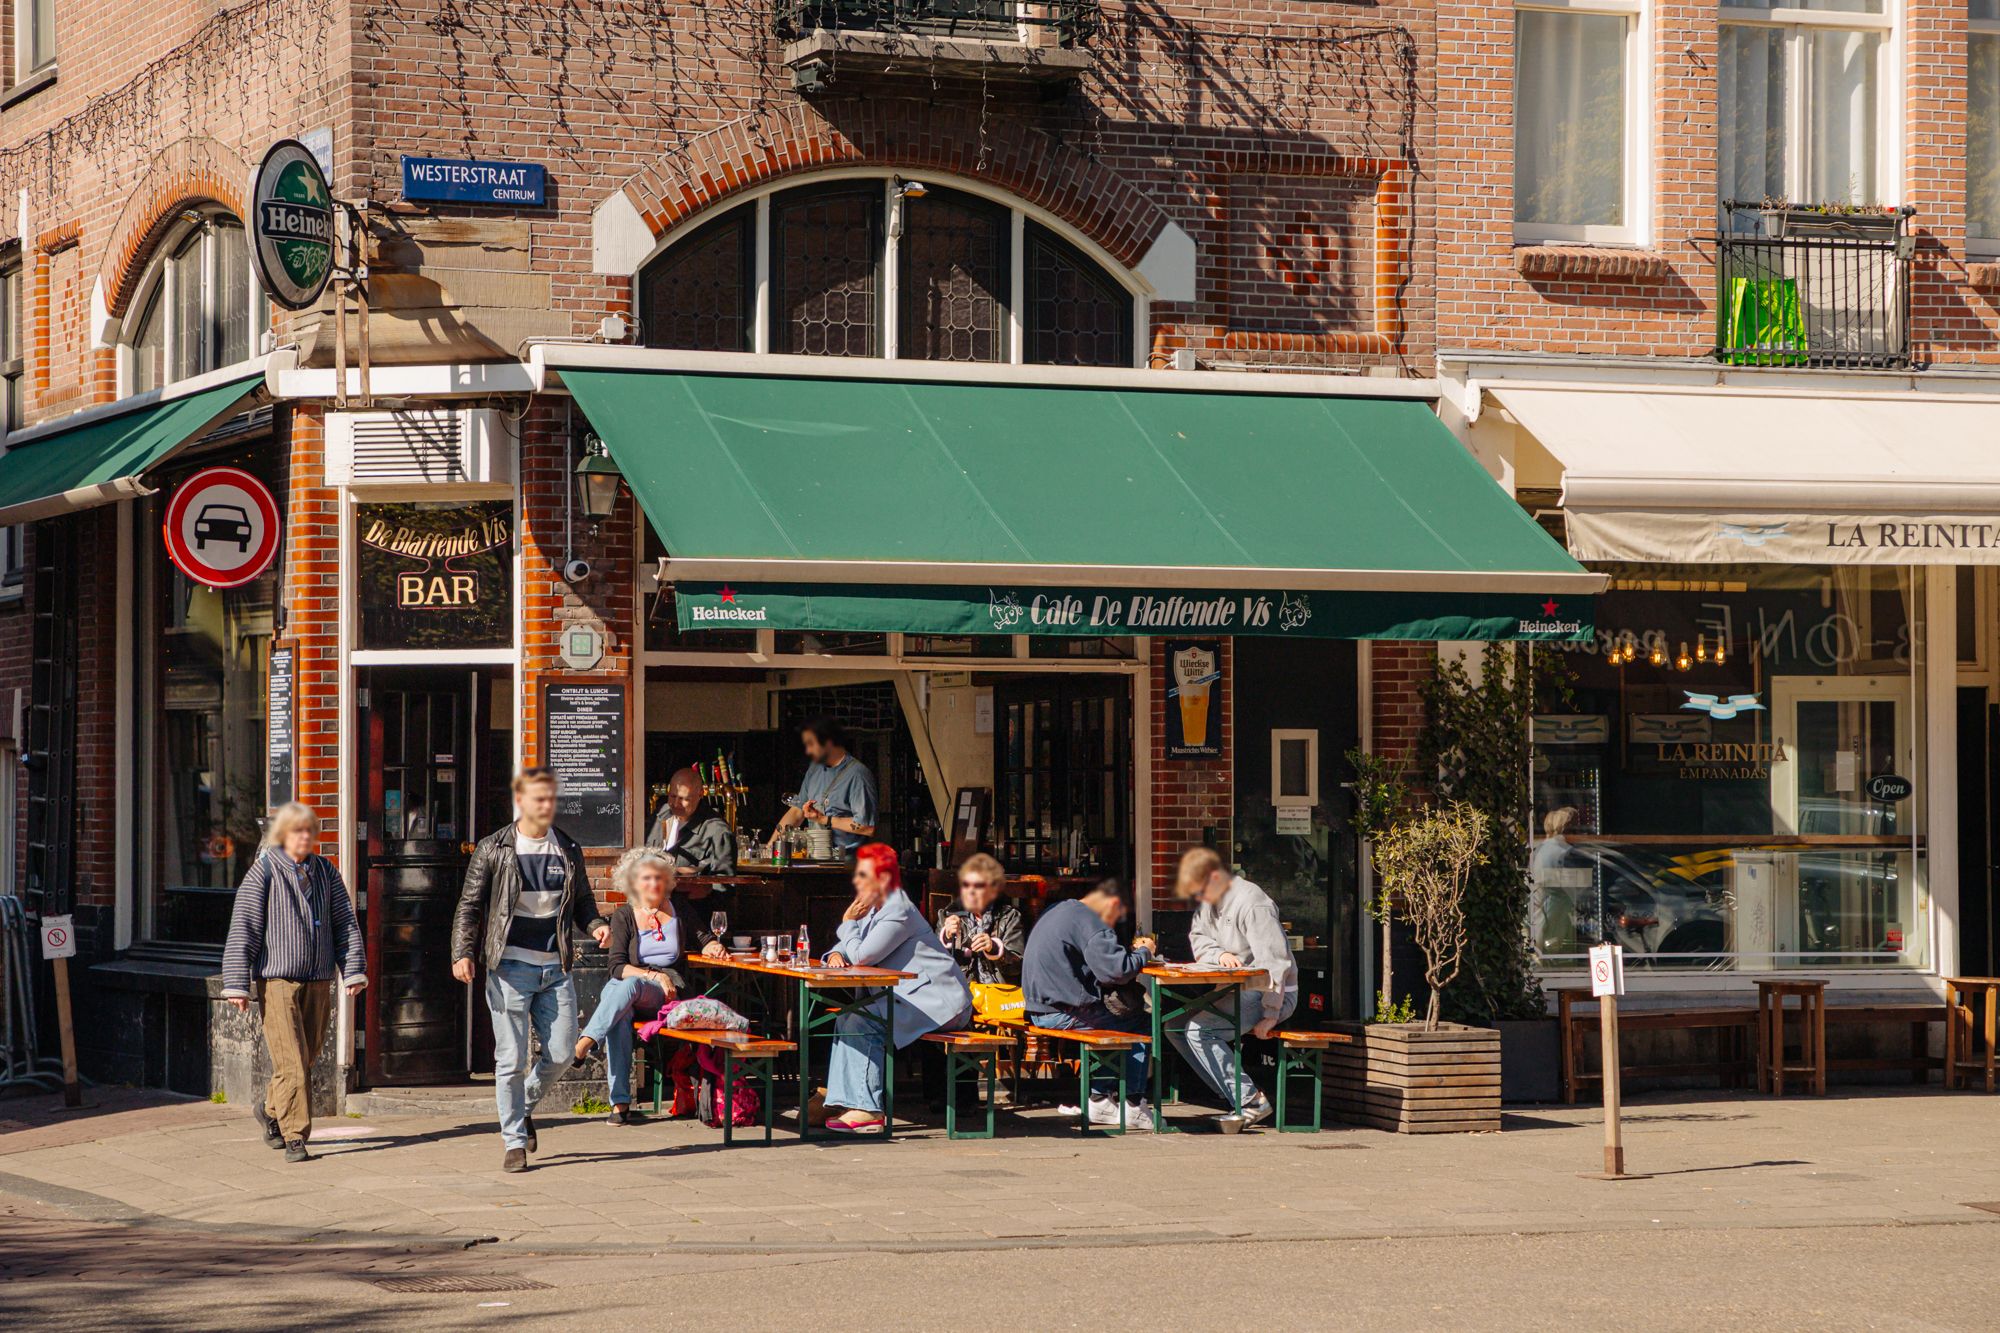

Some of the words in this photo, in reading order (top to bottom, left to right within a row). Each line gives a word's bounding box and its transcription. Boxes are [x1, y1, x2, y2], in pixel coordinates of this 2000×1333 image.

[411, 164, 527, 186] WESTERSTRAAT
[493, 189, 535, 201] CENTRUM
[268, 207, 334, 239] Heinek
[366, 519, 393, 547] De
[391, 527, 479, 557] Blaffende
[482, 517, 507, 547] Vis
[1827, 523, 1868, 547] LA
[401, 576, 476, 606] BAR
[692, 606, 766, 621] Heineken
[1030, 594, 1082, 626] Cafe
[1090, 595, 1122, 627] De
[1127, 596, 1237, 628] Blaffende
[1243, 595, 1273, 628] Vis
[1519, 620, 1580, 633] Heineken
[1180, 659, 1210, 668] Wieckse
[1184, 668, 1204, 677] Witte
[1657, 743, 1687, 762] LA
[1693, 743, 1788, 762] REINITA
[1679, 768, 1767, 779] EMPANADAS
[1872, 778, 1905, 797] Open
